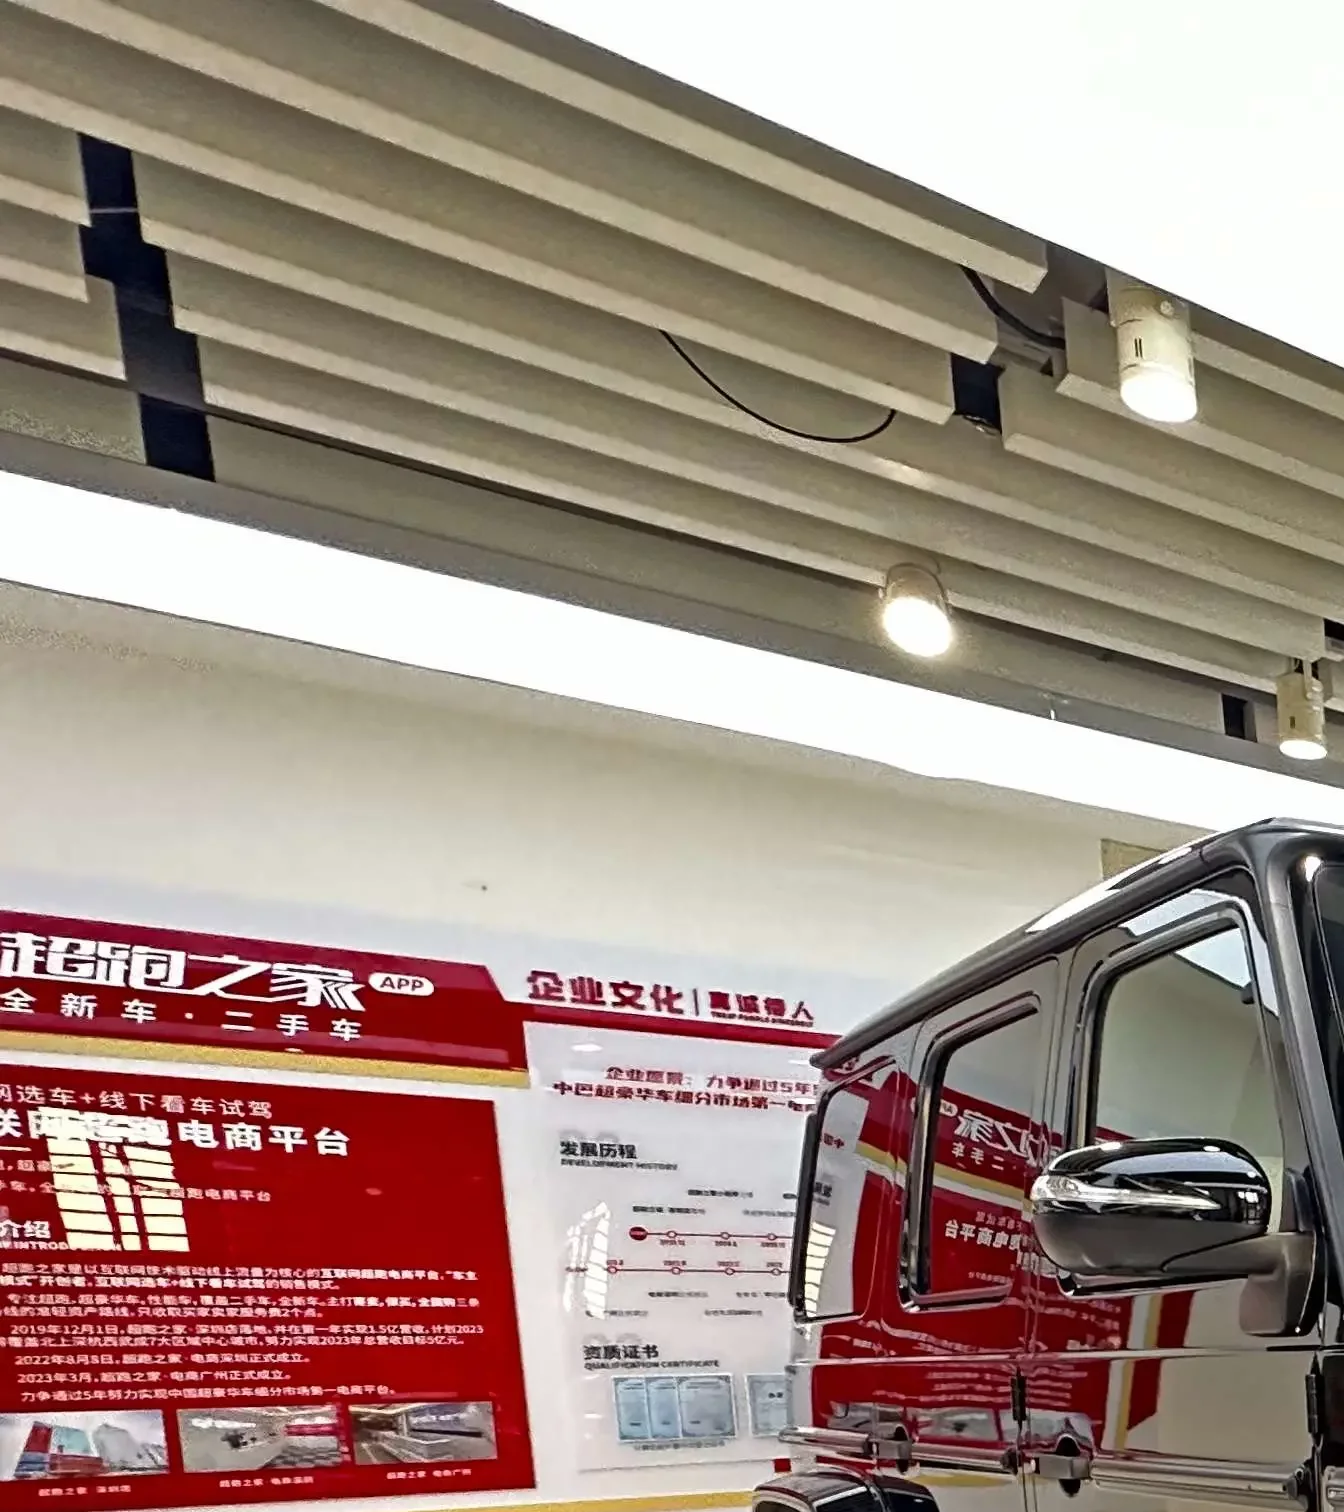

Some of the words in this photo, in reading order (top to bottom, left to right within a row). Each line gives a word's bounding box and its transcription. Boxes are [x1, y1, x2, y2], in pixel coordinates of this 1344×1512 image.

[380, 976, 424, 992] APP
[527, 970, 684, 1015] 企业文化
[560, 1141, 637, 1159] 发展历程
[583, 1345, 659, 1360] 资质证书
